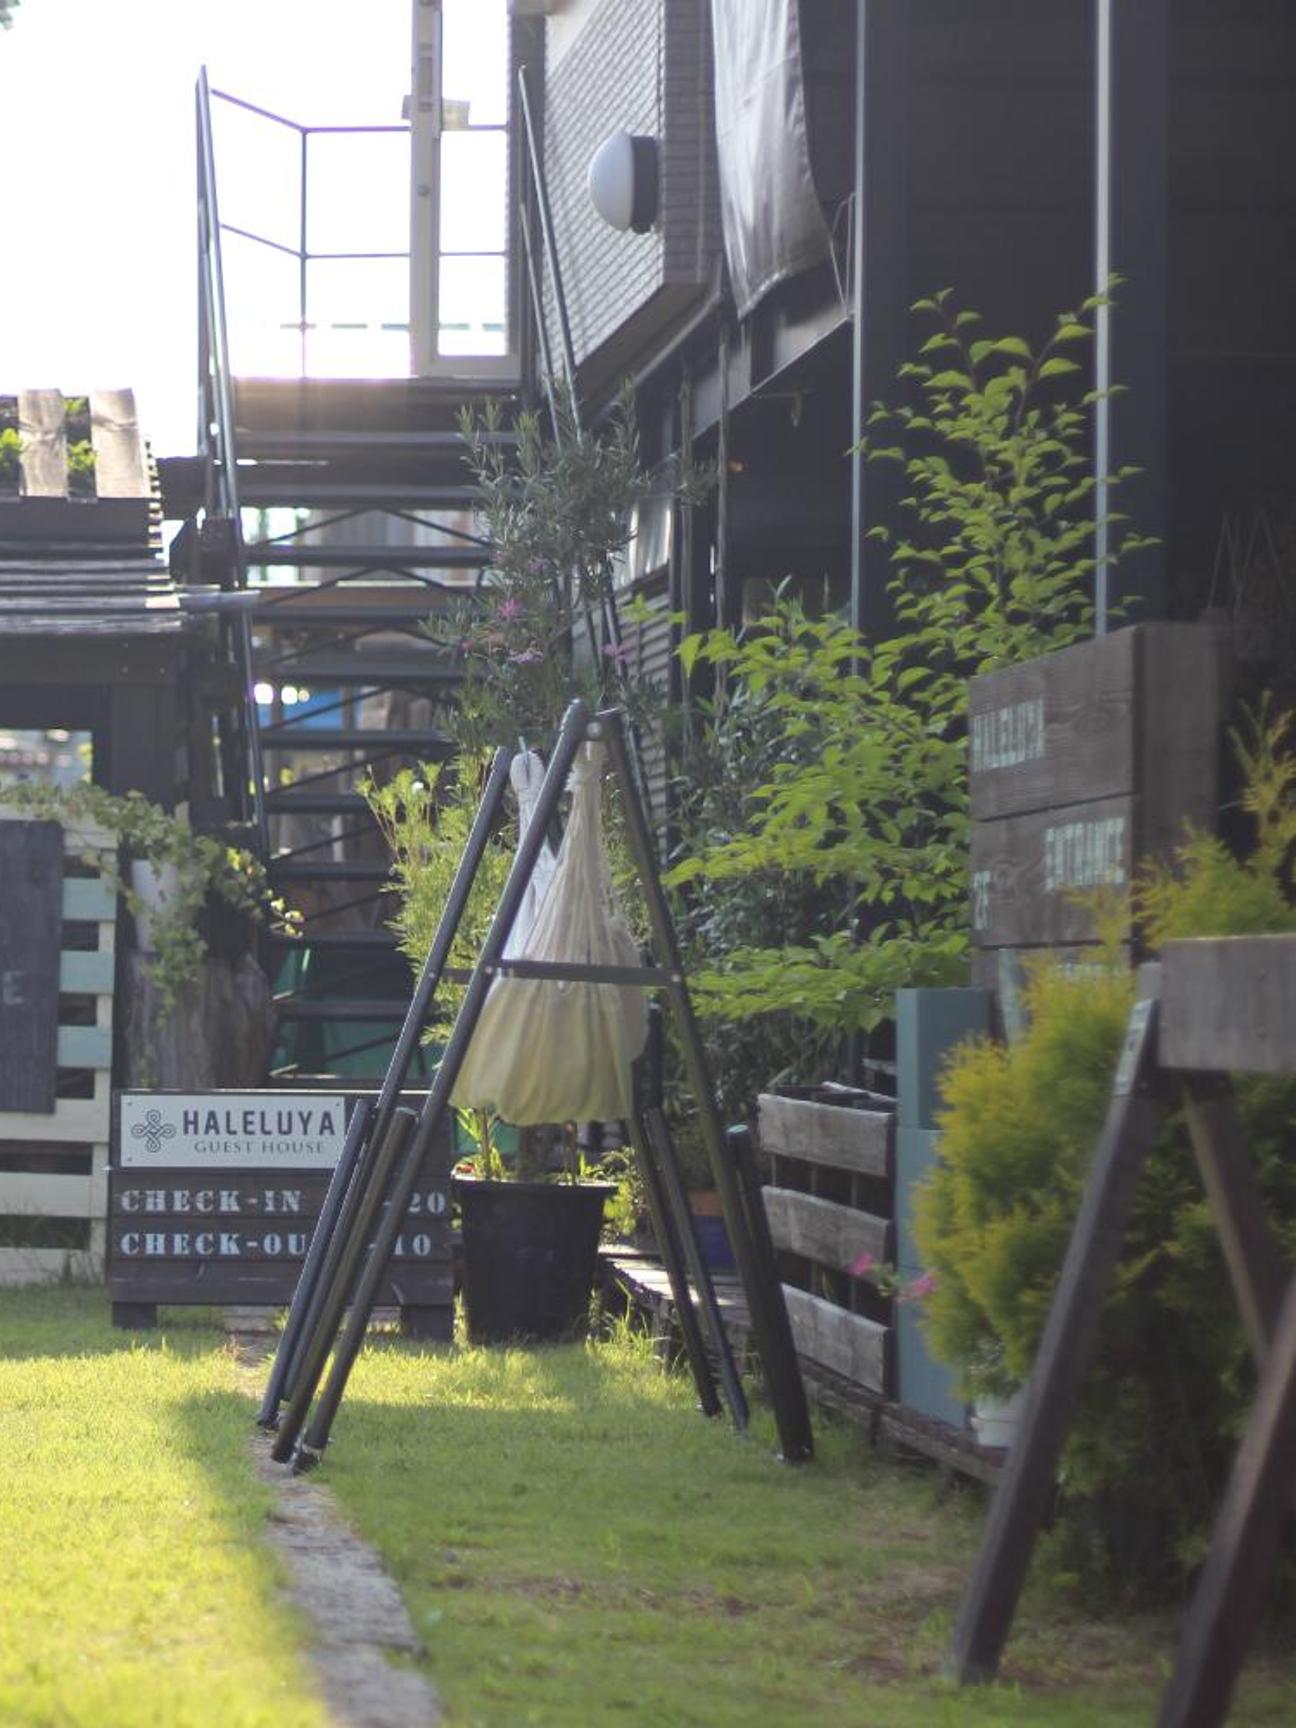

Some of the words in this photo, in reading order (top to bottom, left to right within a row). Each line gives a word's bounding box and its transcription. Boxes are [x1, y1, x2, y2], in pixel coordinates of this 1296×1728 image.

[182, 1109, 336, 1137] HALELUYA
[194, 1140, 252, 1154] GUEST
[262, 1141, 324, 1155] HOUSE
[120, 1189, 302, 1213] CHECK-IN
[120, 1232, 306, 1256] CHECK-OU
